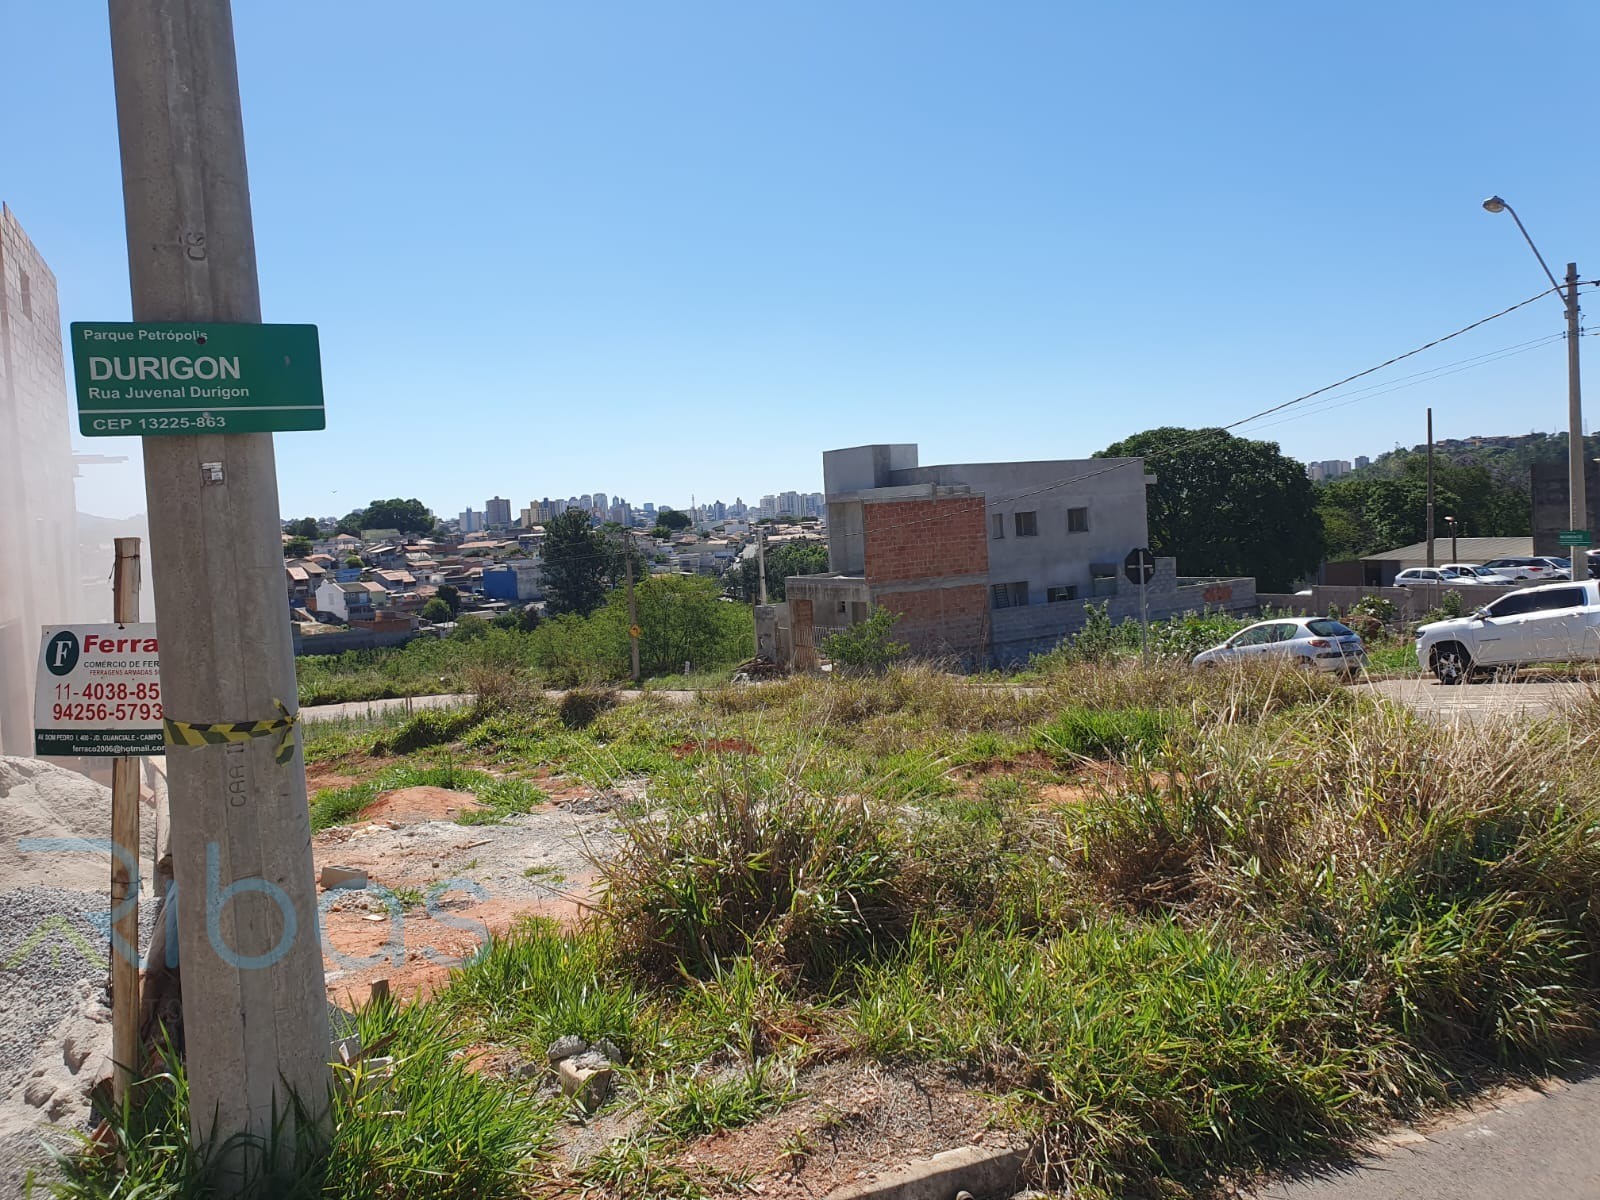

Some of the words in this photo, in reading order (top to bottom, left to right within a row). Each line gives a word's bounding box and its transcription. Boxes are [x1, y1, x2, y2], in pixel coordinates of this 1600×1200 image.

[83, 329, 134, 342] Parque
[138, 329, 208, 343] Petrópolis
[89, 356, 241, 381] DURIGON
[88, 387, 120, 399] Rua
[125, 386, 186, 399] Juvenal
[190, 386, 250, 400] Durigon
[93, 418, 132, 430] CEP
[138, 415, 226, 430] 13225-863
[83, 634, 159, 654] Ferra
[53, 640, 72, 667] F
[129, 660, 140, 668] DE
[142, 660, 160, 668] FER
[52, 703, 164, 721] 94256-5793
